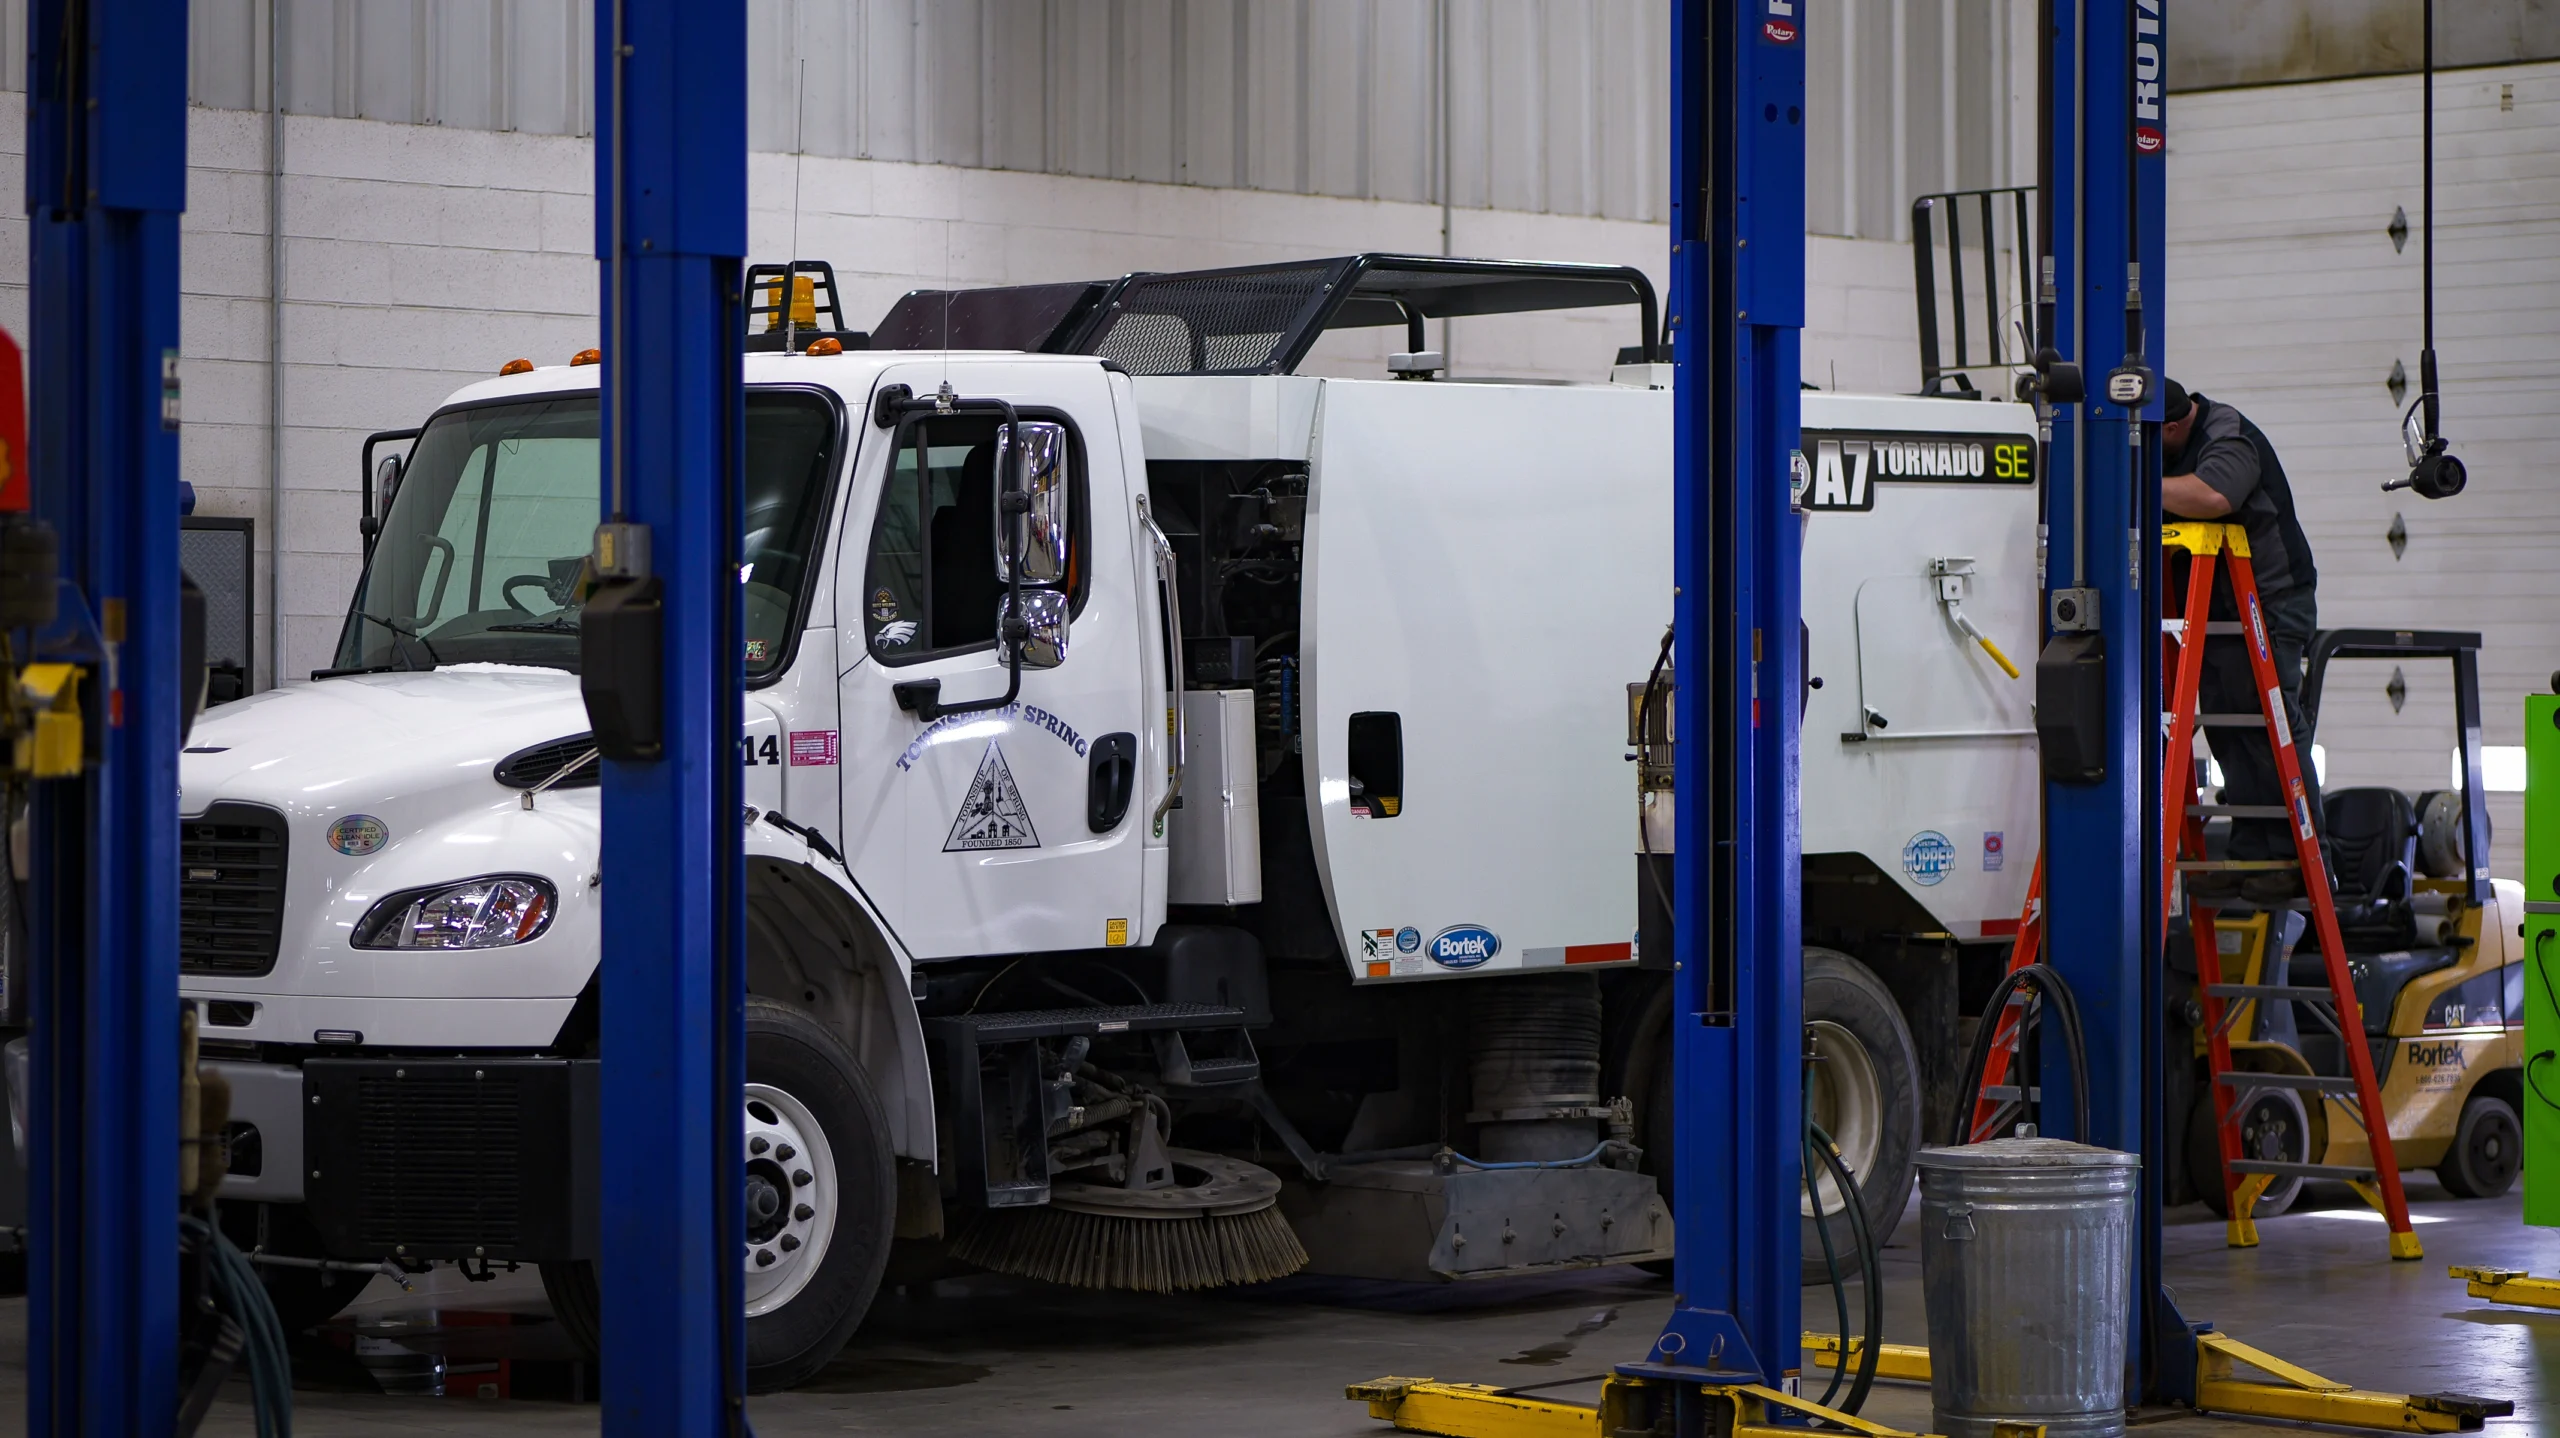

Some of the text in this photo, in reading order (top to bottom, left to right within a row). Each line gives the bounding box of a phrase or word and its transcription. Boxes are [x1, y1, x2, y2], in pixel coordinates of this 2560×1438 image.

[1766, 23, 1794, 40] Rotary
[2136, 133, 2161, 150] otary
[1814, 440, 2030, 505] A7 TORNADO SE
[1024, 704, 1089, 758] SPRING
[743, 735, 779, 766] 14
[959, 768, 1027, 823] TOWNSHIP OF SPRING
[962, 838, 1022, 848] FOUNDED 1850
[1903, 845, 1955, 872] HOPPER
[1440, 936, 1488, 957] Bortek
[2445, 1004, 2466, 1027] CAT
[2409, 1040, 2467, 1069] Bortek
